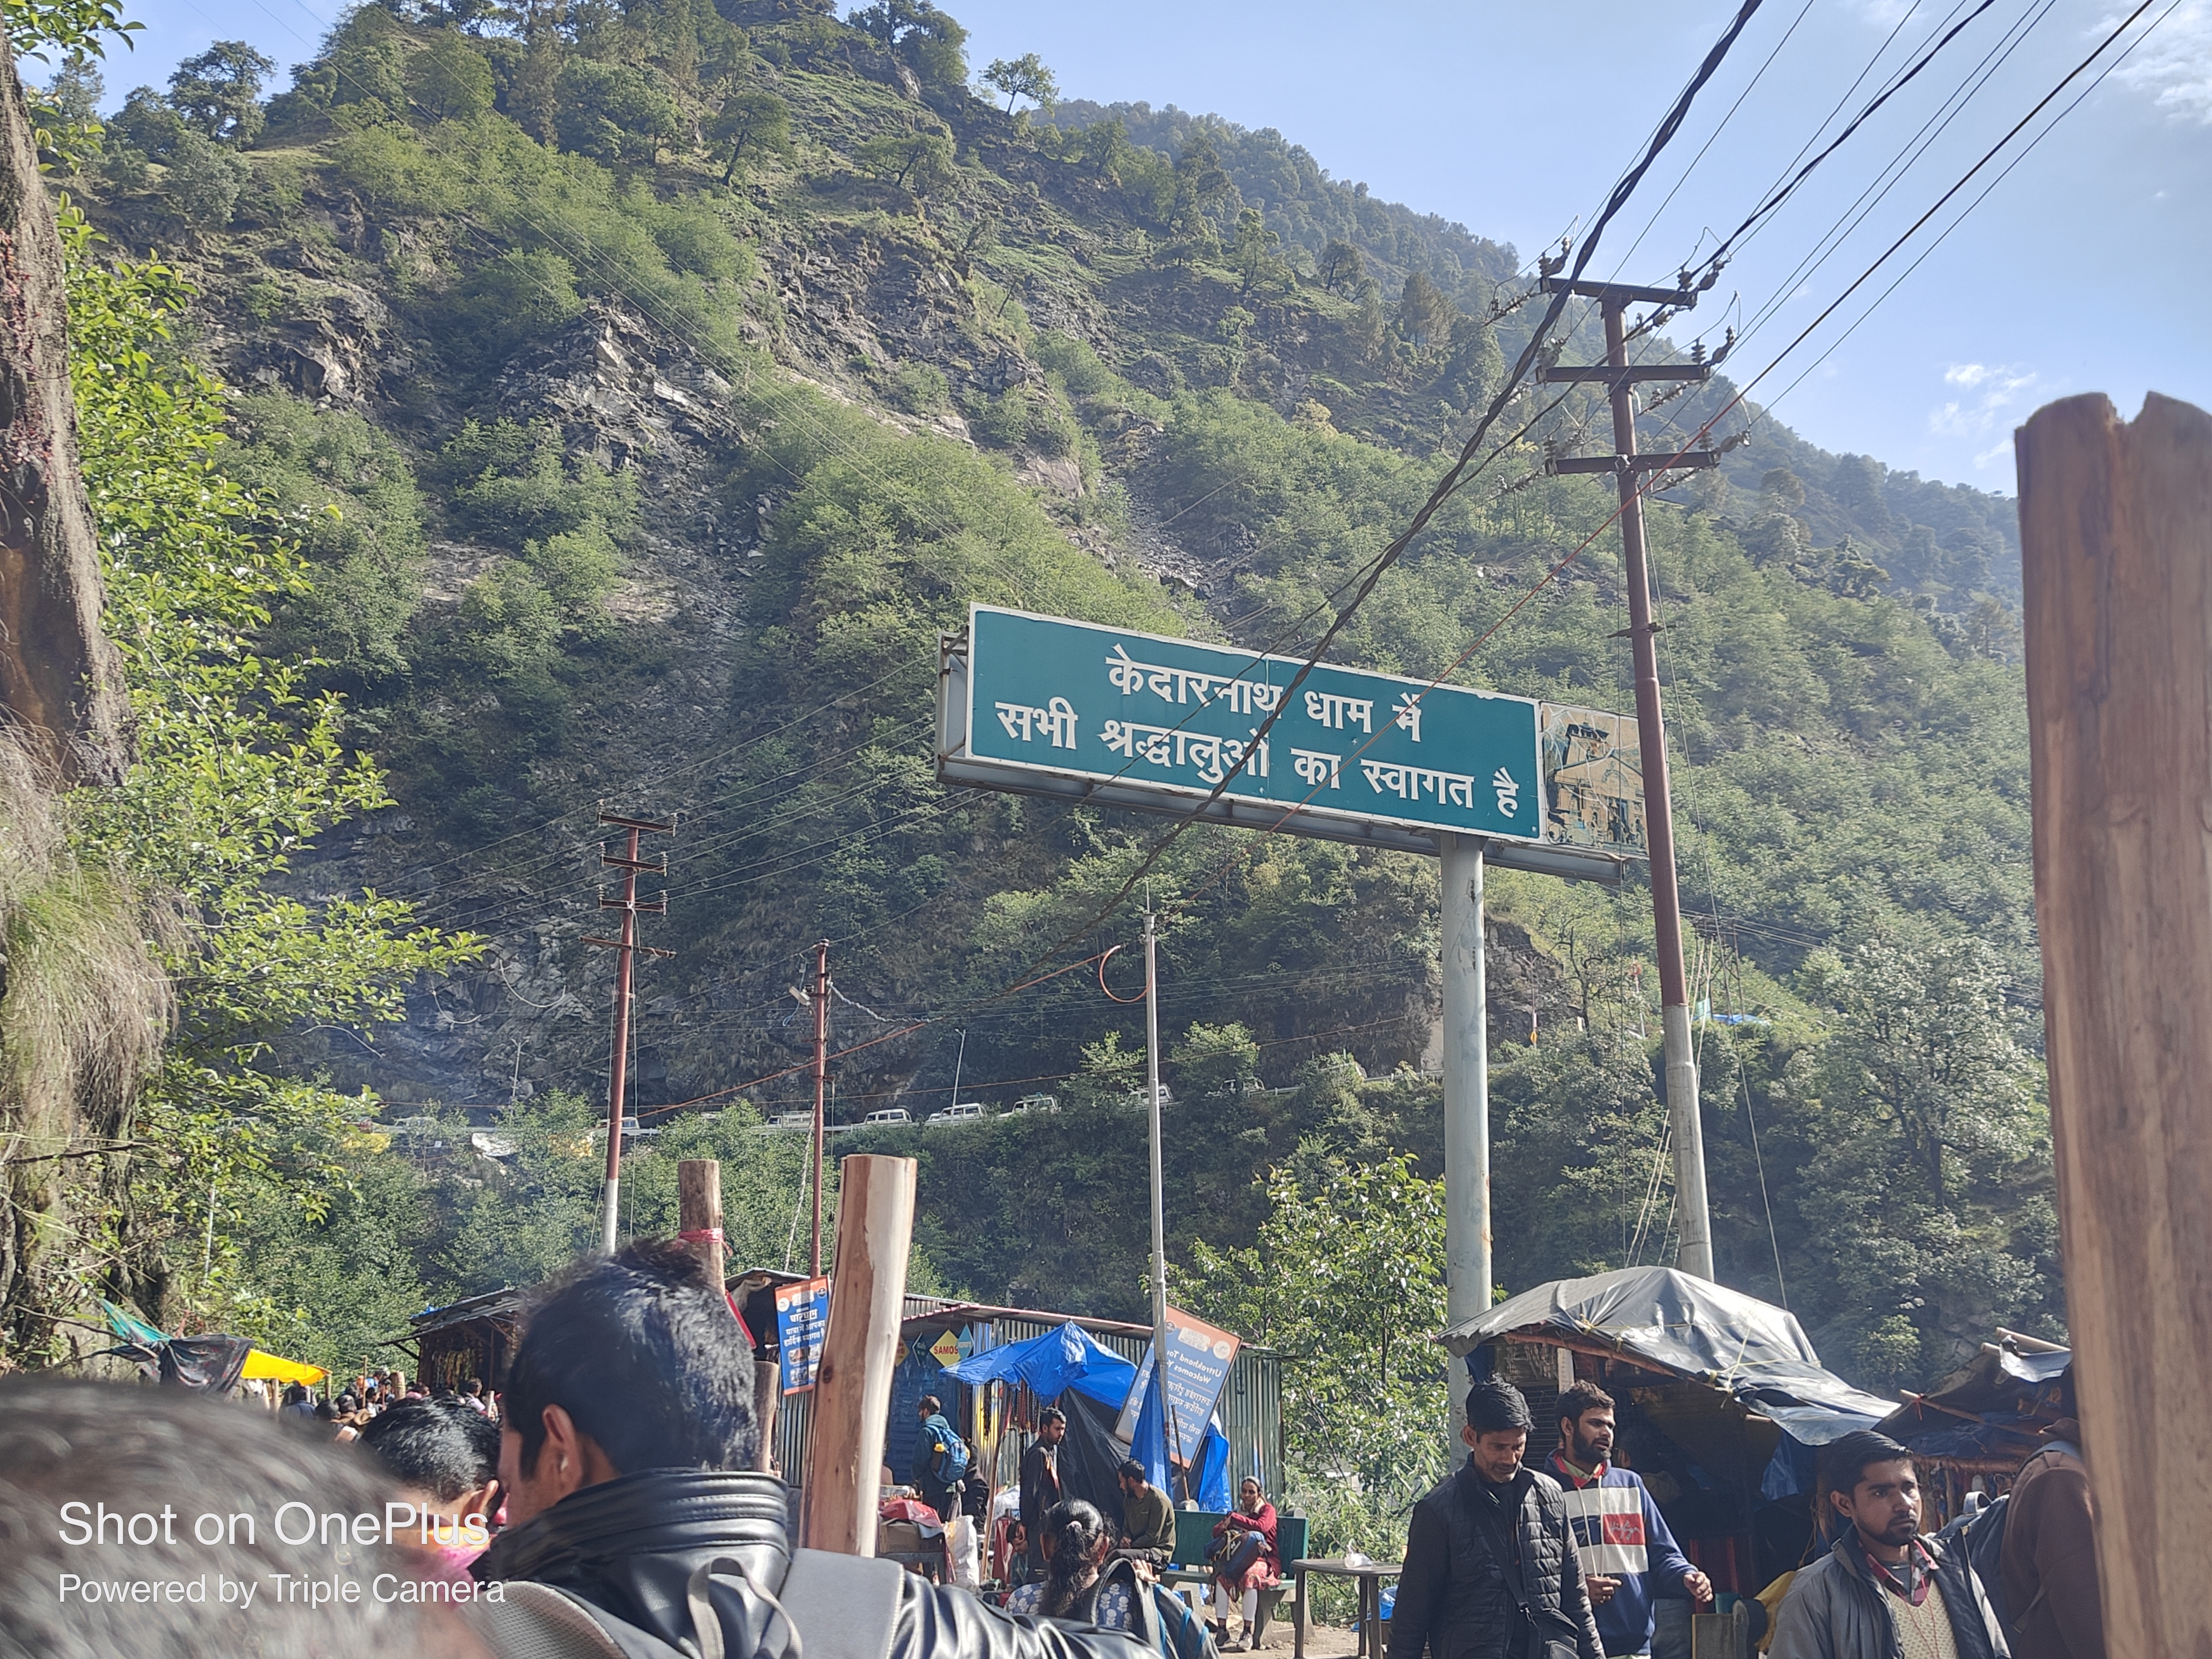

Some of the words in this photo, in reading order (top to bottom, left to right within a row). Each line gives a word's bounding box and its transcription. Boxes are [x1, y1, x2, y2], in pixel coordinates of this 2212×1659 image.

[1105, 643, 1283, 719] केदारनाथ
[1304, 690, 1374, 734] धाम
[1392, 692, 1422, 743] में
[994, 696, 1078, 750] सभी
[1289, 747, 1341, 790] का
[1359, 758, 1475, 809] स्वागत
[1492, 766, 1520, 819] है
